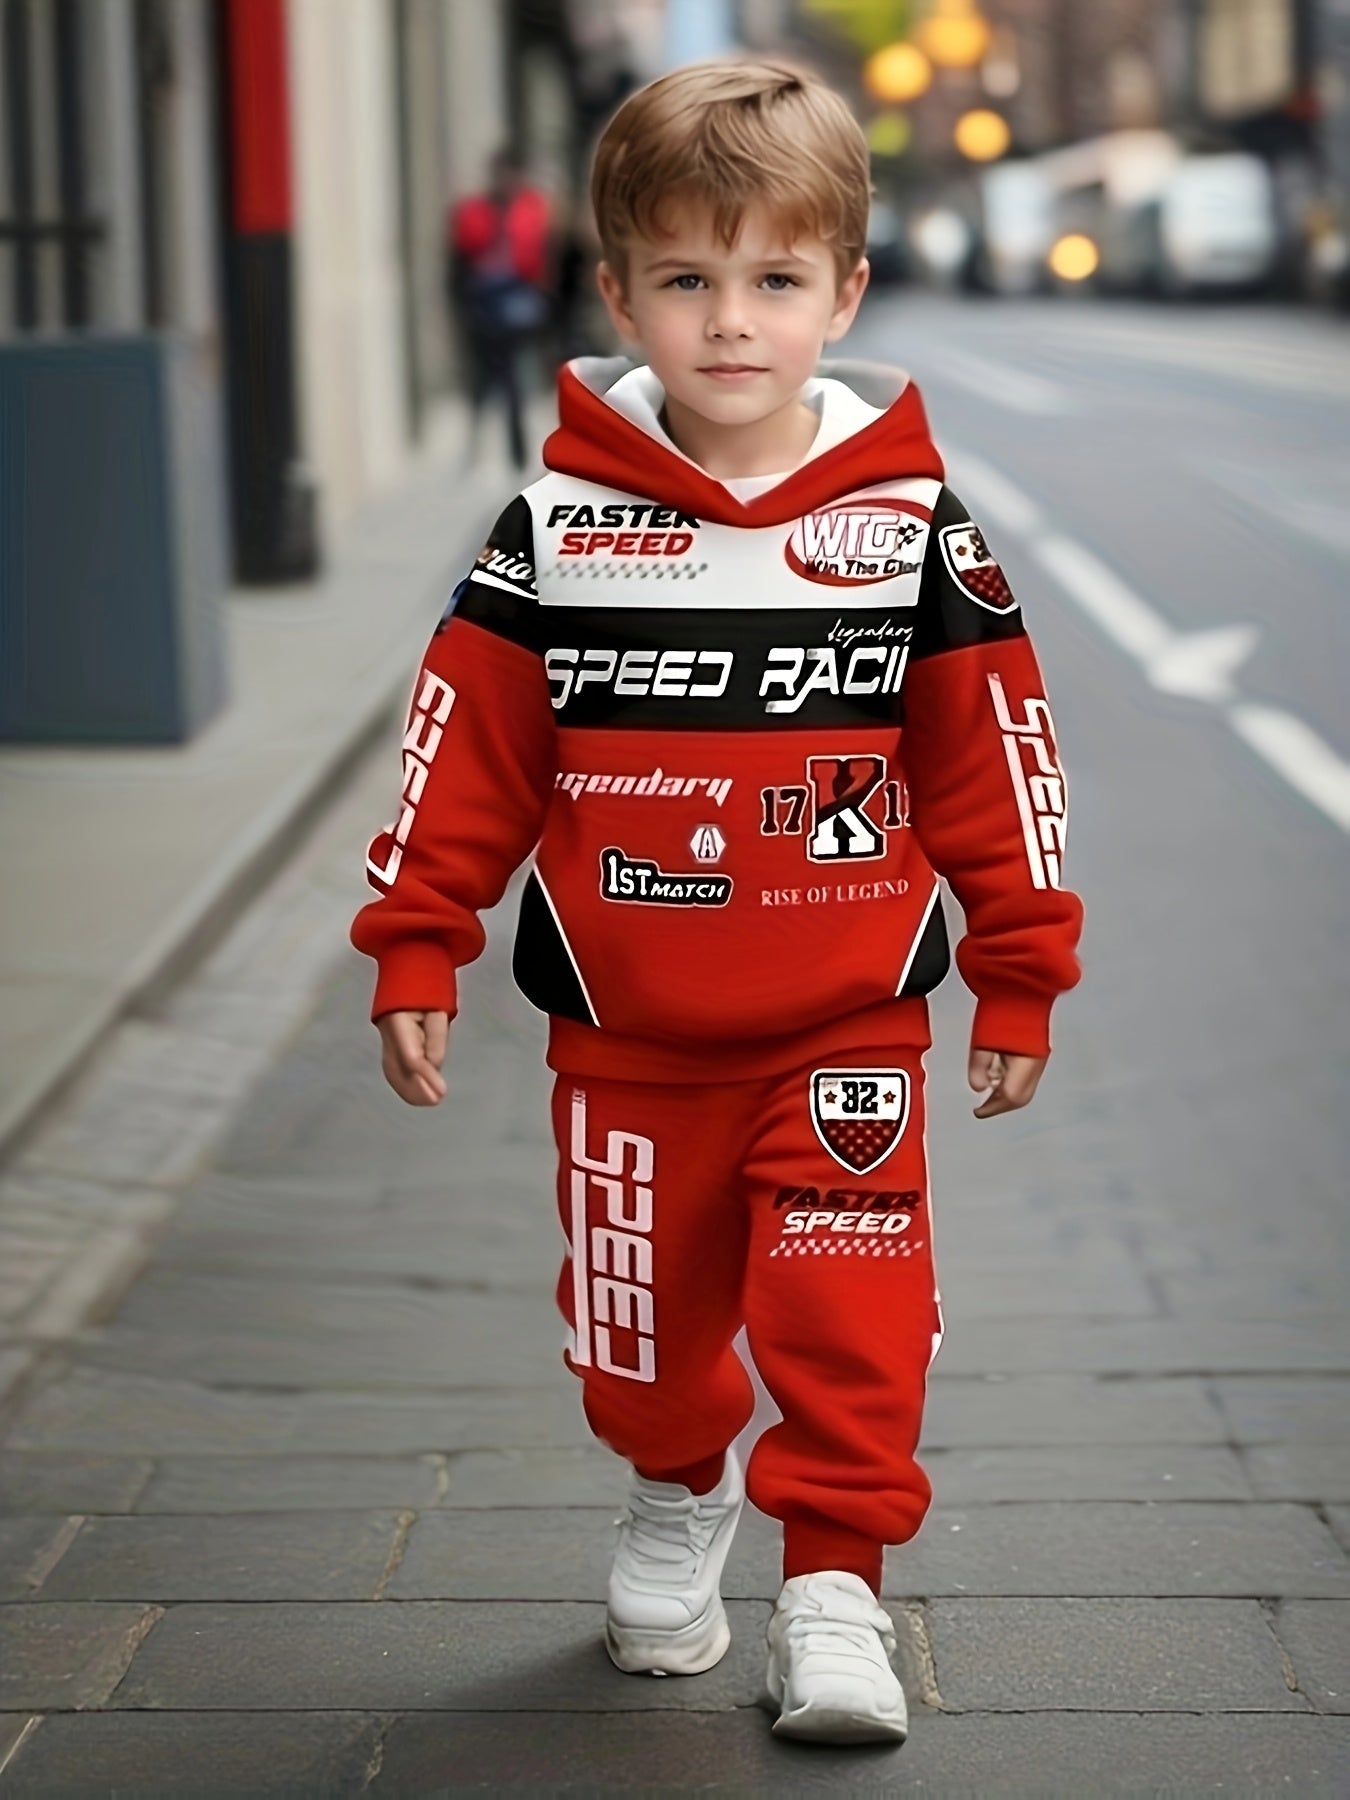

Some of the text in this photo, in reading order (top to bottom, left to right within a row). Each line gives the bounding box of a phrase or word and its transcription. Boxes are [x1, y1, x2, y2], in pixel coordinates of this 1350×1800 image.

[558, 532, 694, 556] SPEED
[801, 513, 900, 559] WTG
[544, 648, 734, 710] SPEED
[760, 754, 912, 864] 17 K 1
[761, 878, 909, 907] RISE OF LEGEND
[772, 1185, 921, 1212] FASTER
[571, 1088, 656, 1383] SPEED
[781, 1211, 912, 1235] SPEED
